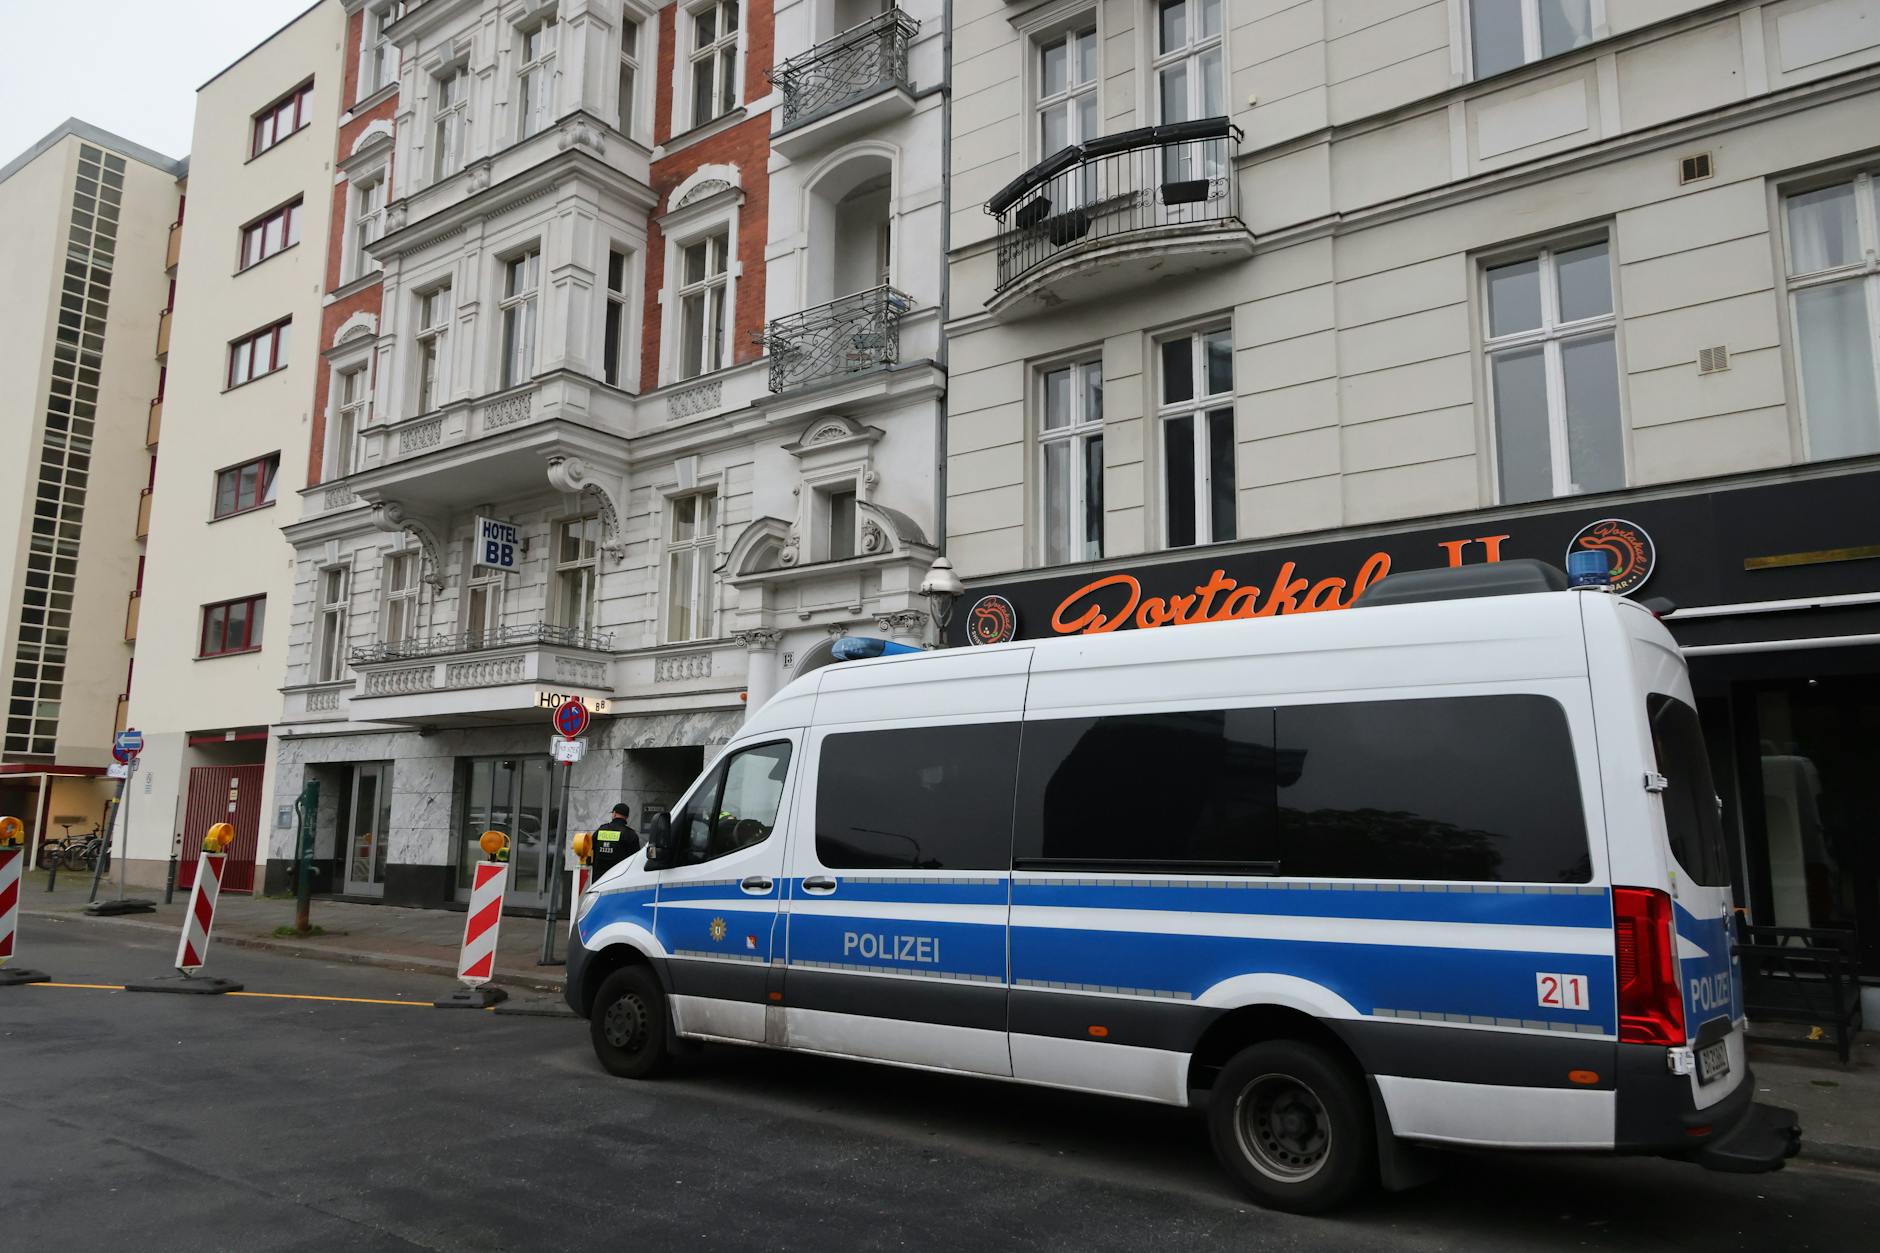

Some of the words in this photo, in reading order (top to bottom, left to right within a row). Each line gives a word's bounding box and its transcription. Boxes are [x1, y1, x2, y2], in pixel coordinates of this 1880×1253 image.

[483, 520, 519, 545] HOTEL
[1593, 521, 1648, 564] Portakal
[486, 540, 514, 567] BB
[1051, 551, 1392, 636] Portakal
[843, 931, 940, 963] POLIZEI
[1541, 976, 1581, 1007] 21
